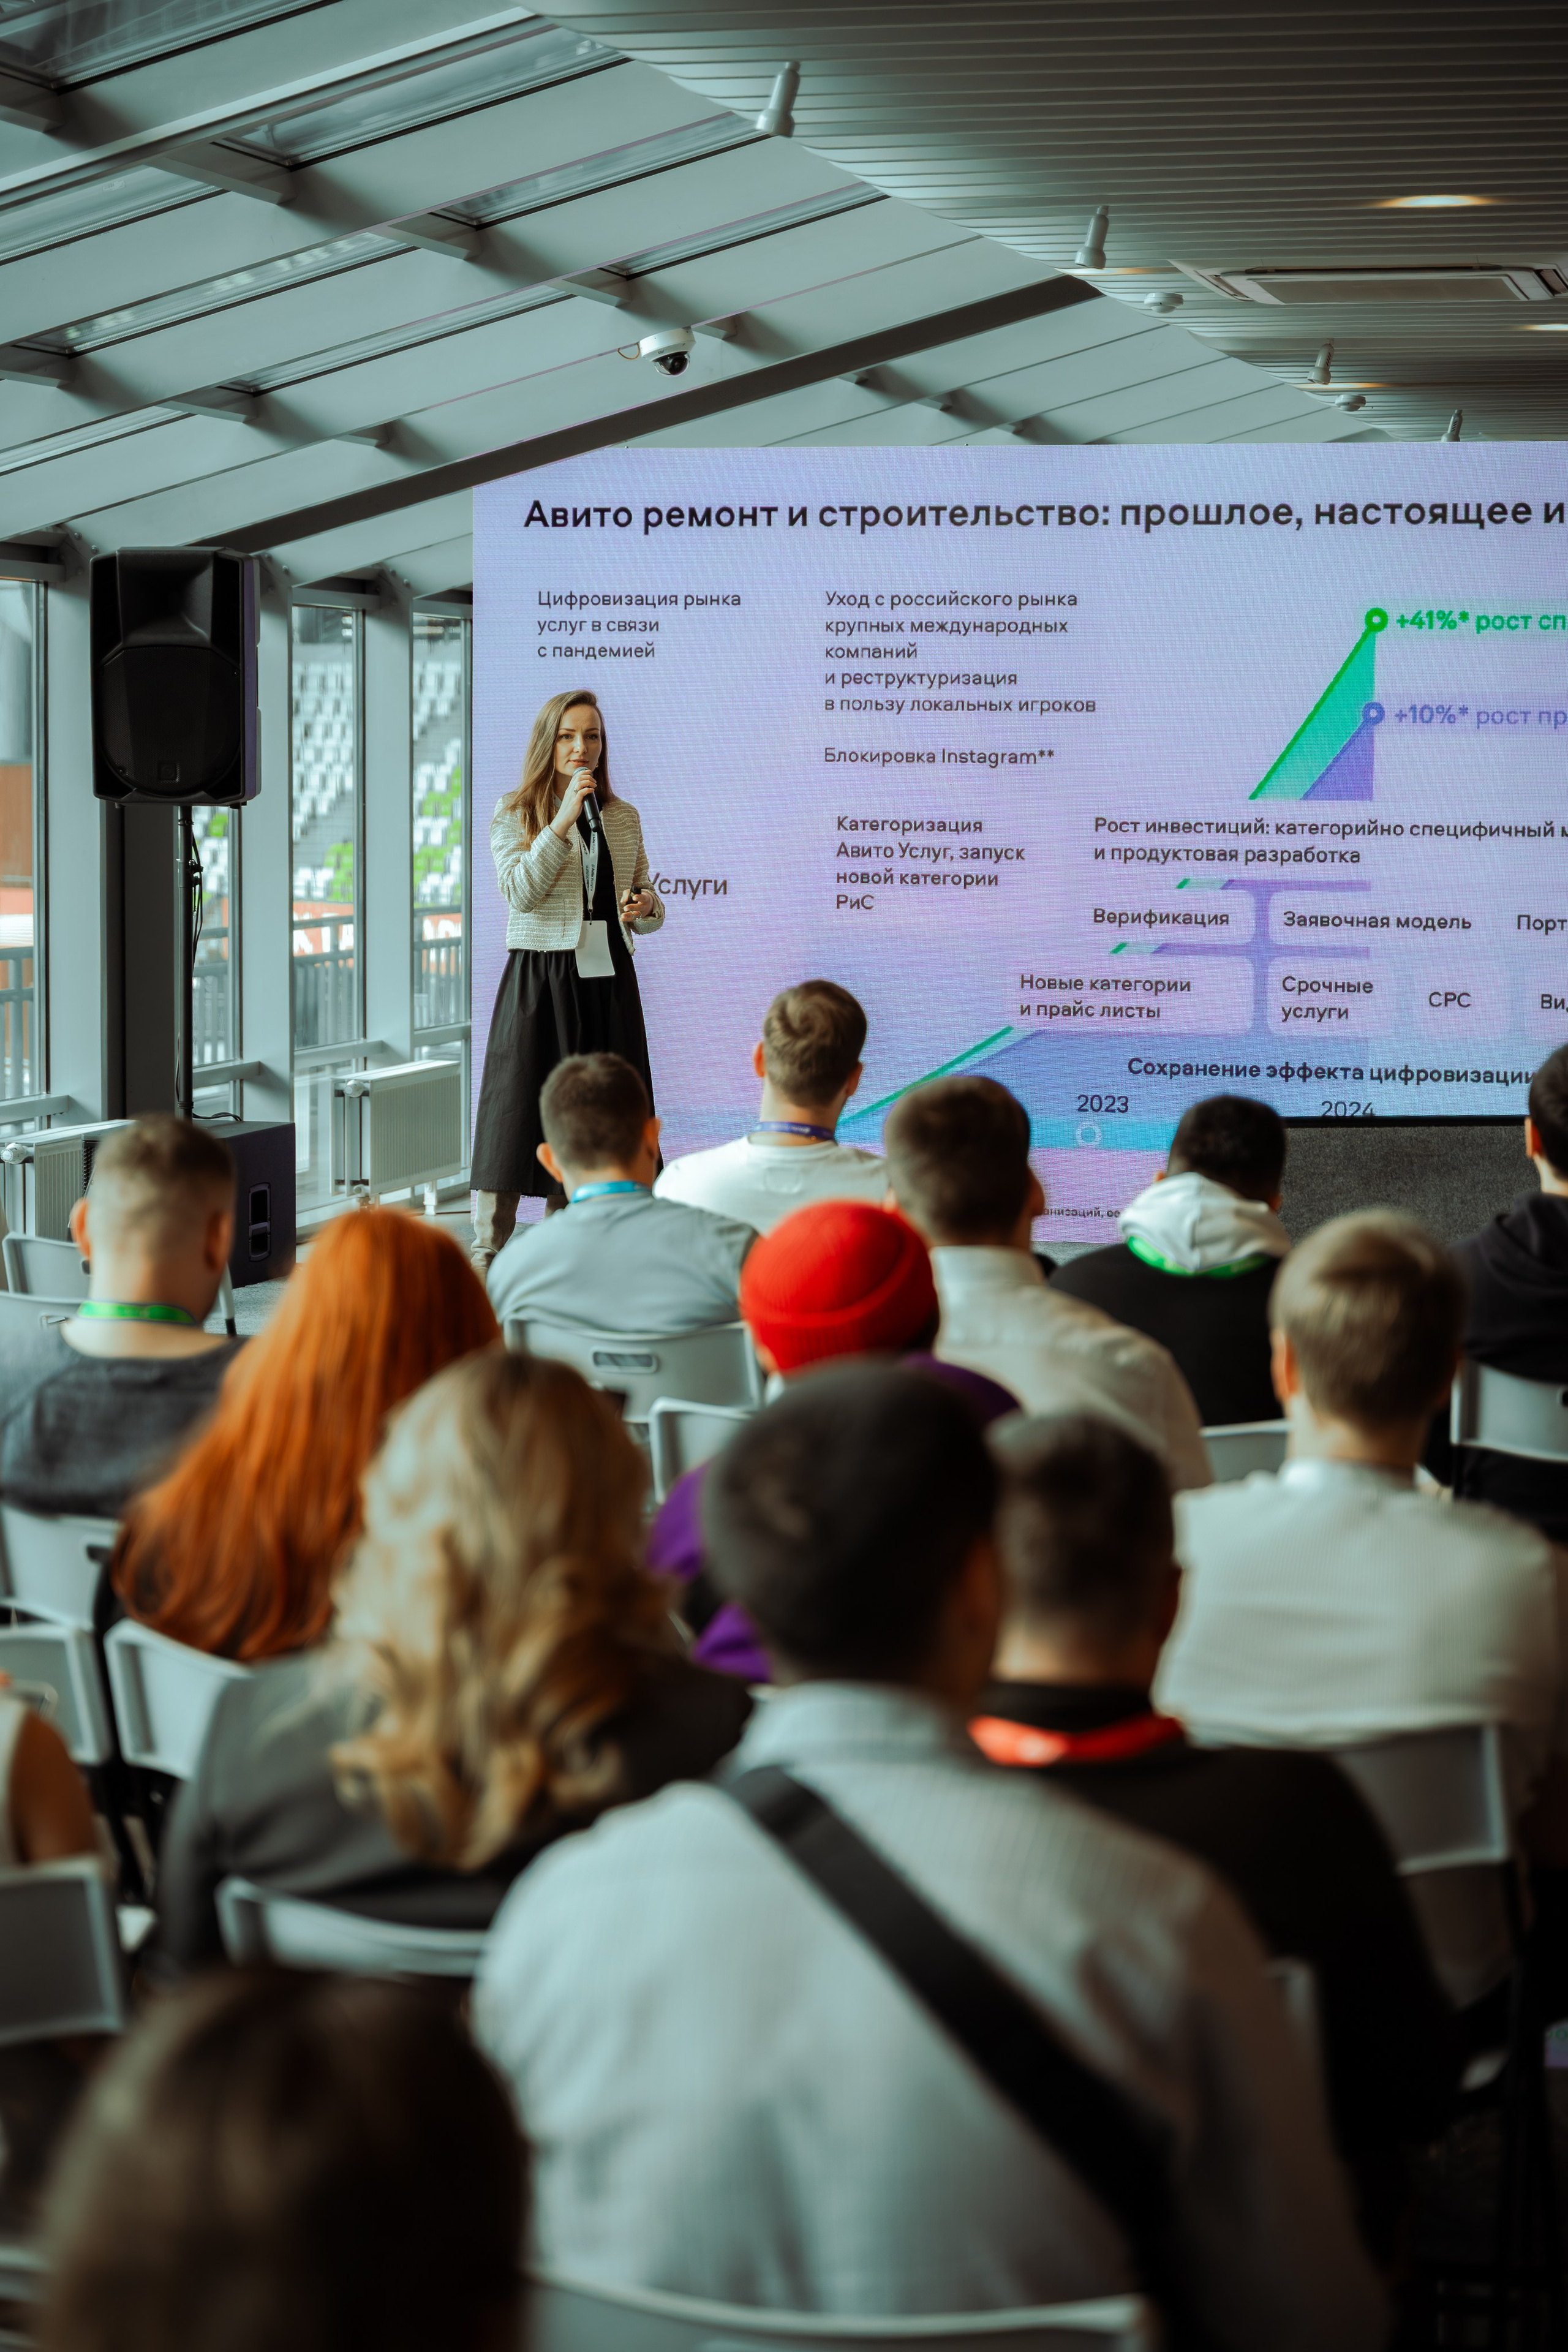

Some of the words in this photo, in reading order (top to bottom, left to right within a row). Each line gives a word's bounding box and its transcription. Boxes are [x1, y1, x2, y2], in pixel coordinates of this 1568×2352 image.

[524, 500, 633, 528] Авито
[644, 506, 778, 535] ремонт
[788, 507, 807, 527] и
[819, 504, 1109, 535] строительство:
[1121, 503, 1303, 533] прошлое,
[1315, 502, 1532, 530] настоящее
[1544, 502, 1564, 524] и
[538, 591, 679, 610] Цифровизация
[684, 594, 741, 610] рынка
[826, 591, 870, 609] Уход
[874, 594, 884, 606] с
[890, 590, 1013, 611] российского
[1018, 594, 1078, 611] рынка
[537, 620, 587, 636] услуг
[591, 620, 601, 632] в
[606, 620, 660, 633] связи
[825, 620, 905, 637] крупных
[910, 620, 1068, 636] международных
[1475, 614, 1532, 635] рост
[537, 646, 547, 658] с
[552, 641, 655, 660] пандемией
[825, 642, 918, 659] компаний
[824, 673, 835, 684] и
[841, 673, 1018, 689] реструктуризация
[824, 699, 835, 710] в
[840, 699, 905, 715] пользу
[910, 699, 1012, 712] локальных
[1018, 700, 1096, 715] игроков
[1476, 710, 1531, 729] рост
[824, 747, 937, 767] Блокировка
[837, 816, 983, 836] Категоризация
[1095, 816, 1140, 833] Рост
[1145, 818, 1270, 836] инвестиций:
[1275, 819, 1404, 840] категорийно
[1409, 821, 1555, 841] специфичный
[836, 842, 894, 859] Авито
[898, 842, 954, 864] Услуг,
[959, 847, 1025, 864] запуск
[1094, 848, 1106, 860] и
[1110, 847, 1238, 865] продуктовая
[1245, 846, 1360, 866] разработка
[836, 867, 894, 884] новой
[899, 873, 999, 889] категории
[836, 894, 874, 910] РиС
[1093, 908, 1229, 929] Верификация
[1284, 911, 1390, 929] Заявочная
[1396, 916, 1472, 932] модель
[1517, 914, 1568, 936] Порт
[1020, 974, 1084, 990] Новые
[1090, 979, 1191, 997] категории
[1282, 975, 1374, 996] Срочные
[1020, 1004, 1031, 1016] и
[1036, 1000, 1095, 1019] прайс
[1100, 1006, 1161, 1019] листы
[1428, 991, 1471, 1008] СРС
[1540, 993, 1568, 1012] Ви
[1281, 1006, 1349, 1023] услуги
[1127, 1057, 1261, 1080] Сохранение
[1266, 1061, 1364, 1084] эффекта
[1077, 1094, 1129, 1114] 2023
[1321, 1101, 1375, 1117] 2024
[1043, 1207, 1104, 1218] анизаций,
